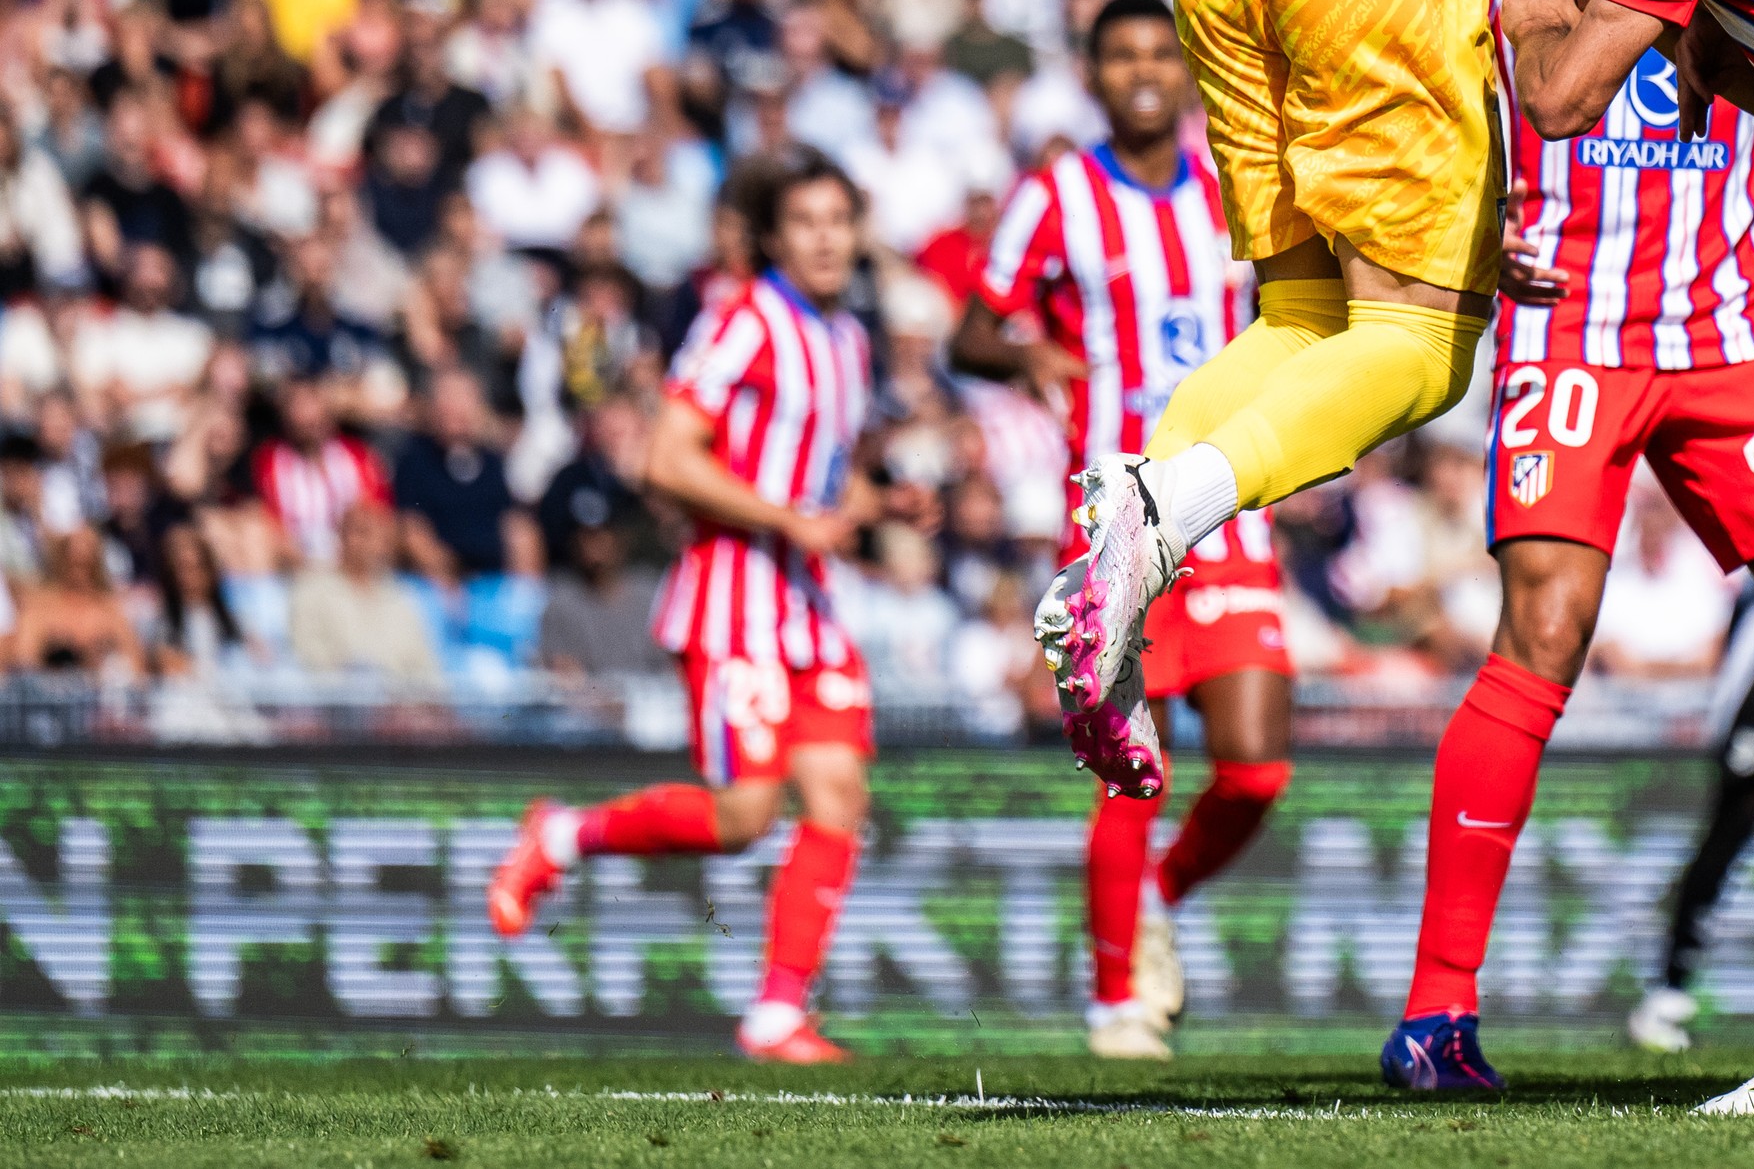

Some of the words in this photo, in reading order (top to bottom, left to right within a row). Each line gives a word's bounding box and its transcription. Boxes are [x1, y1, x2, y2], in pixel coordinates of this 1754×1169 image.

[1583, 139, 1679, 168] RIYADH
[1683, 143, 1725, 169] AIR
[1501, 365, 1600, 449] 20
